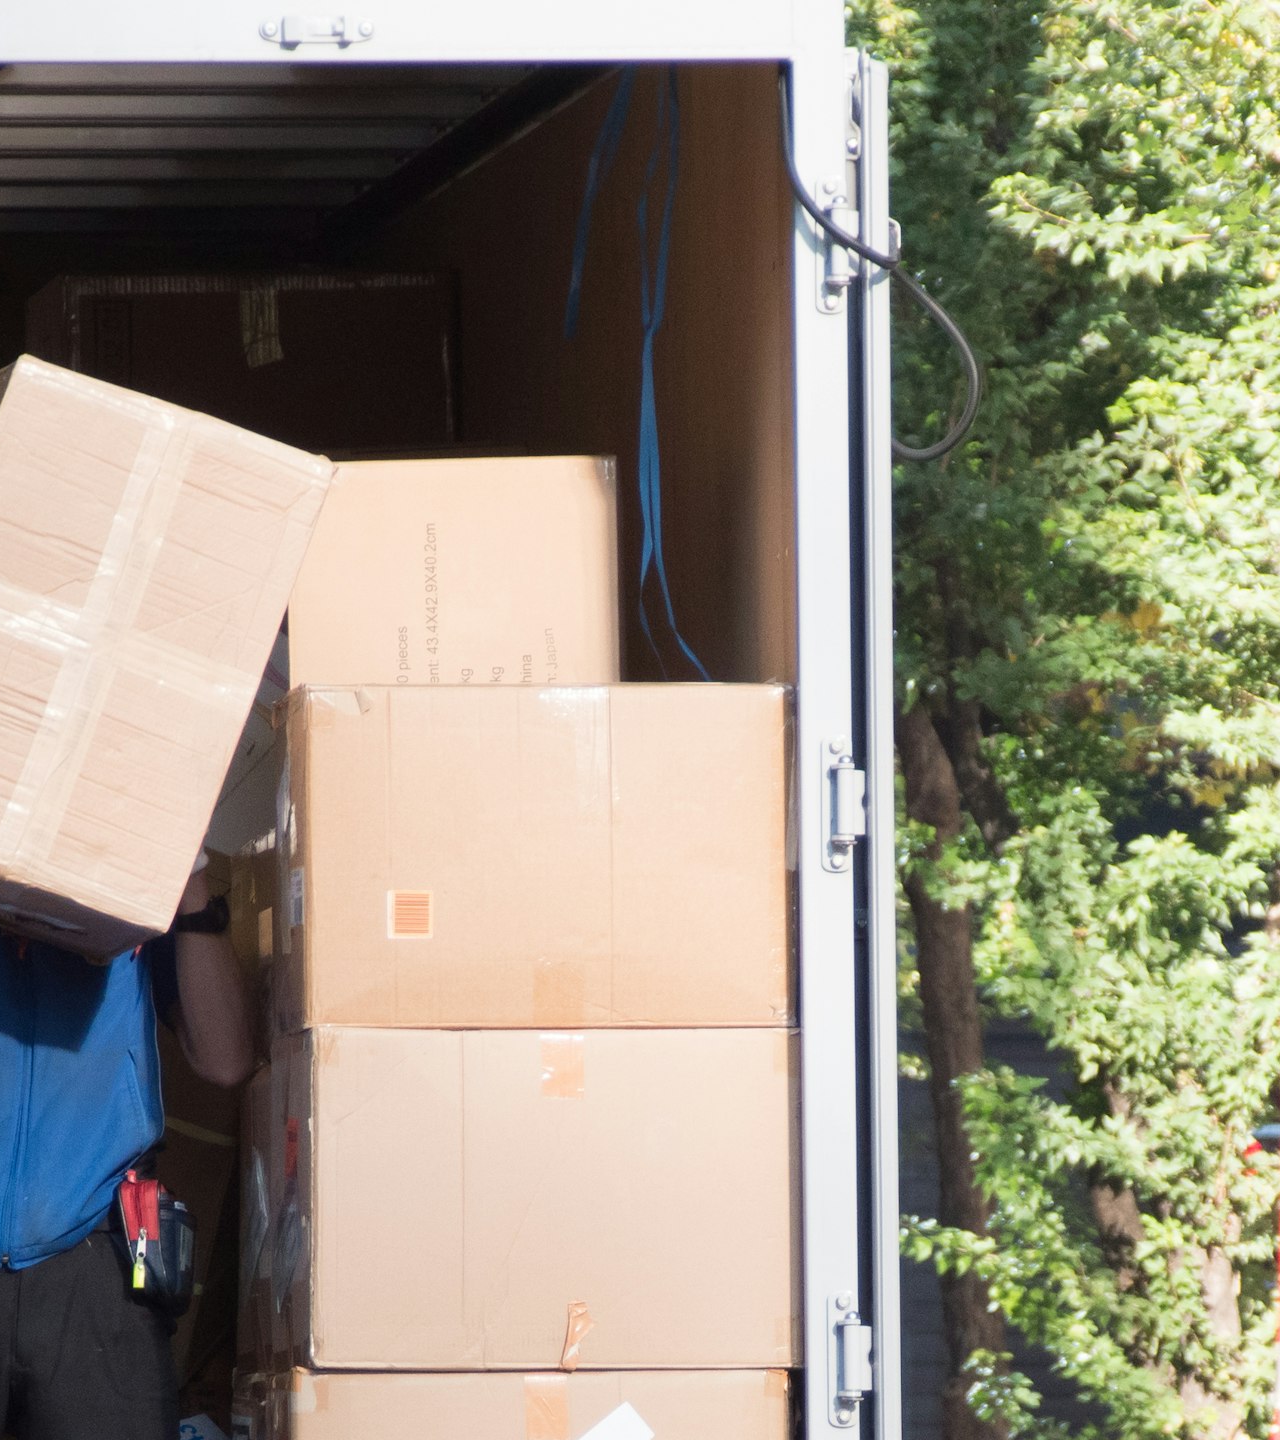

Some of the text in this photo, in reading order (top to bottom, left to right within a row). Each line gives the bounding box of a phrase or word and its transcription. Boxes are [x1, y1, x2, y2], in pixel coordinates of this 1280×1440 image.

[424, 522, 439, 654] 43.4X42.9X40.2cm
[397, 625, 410, 671] pieces
[543, 627, 559, 670] Japan
